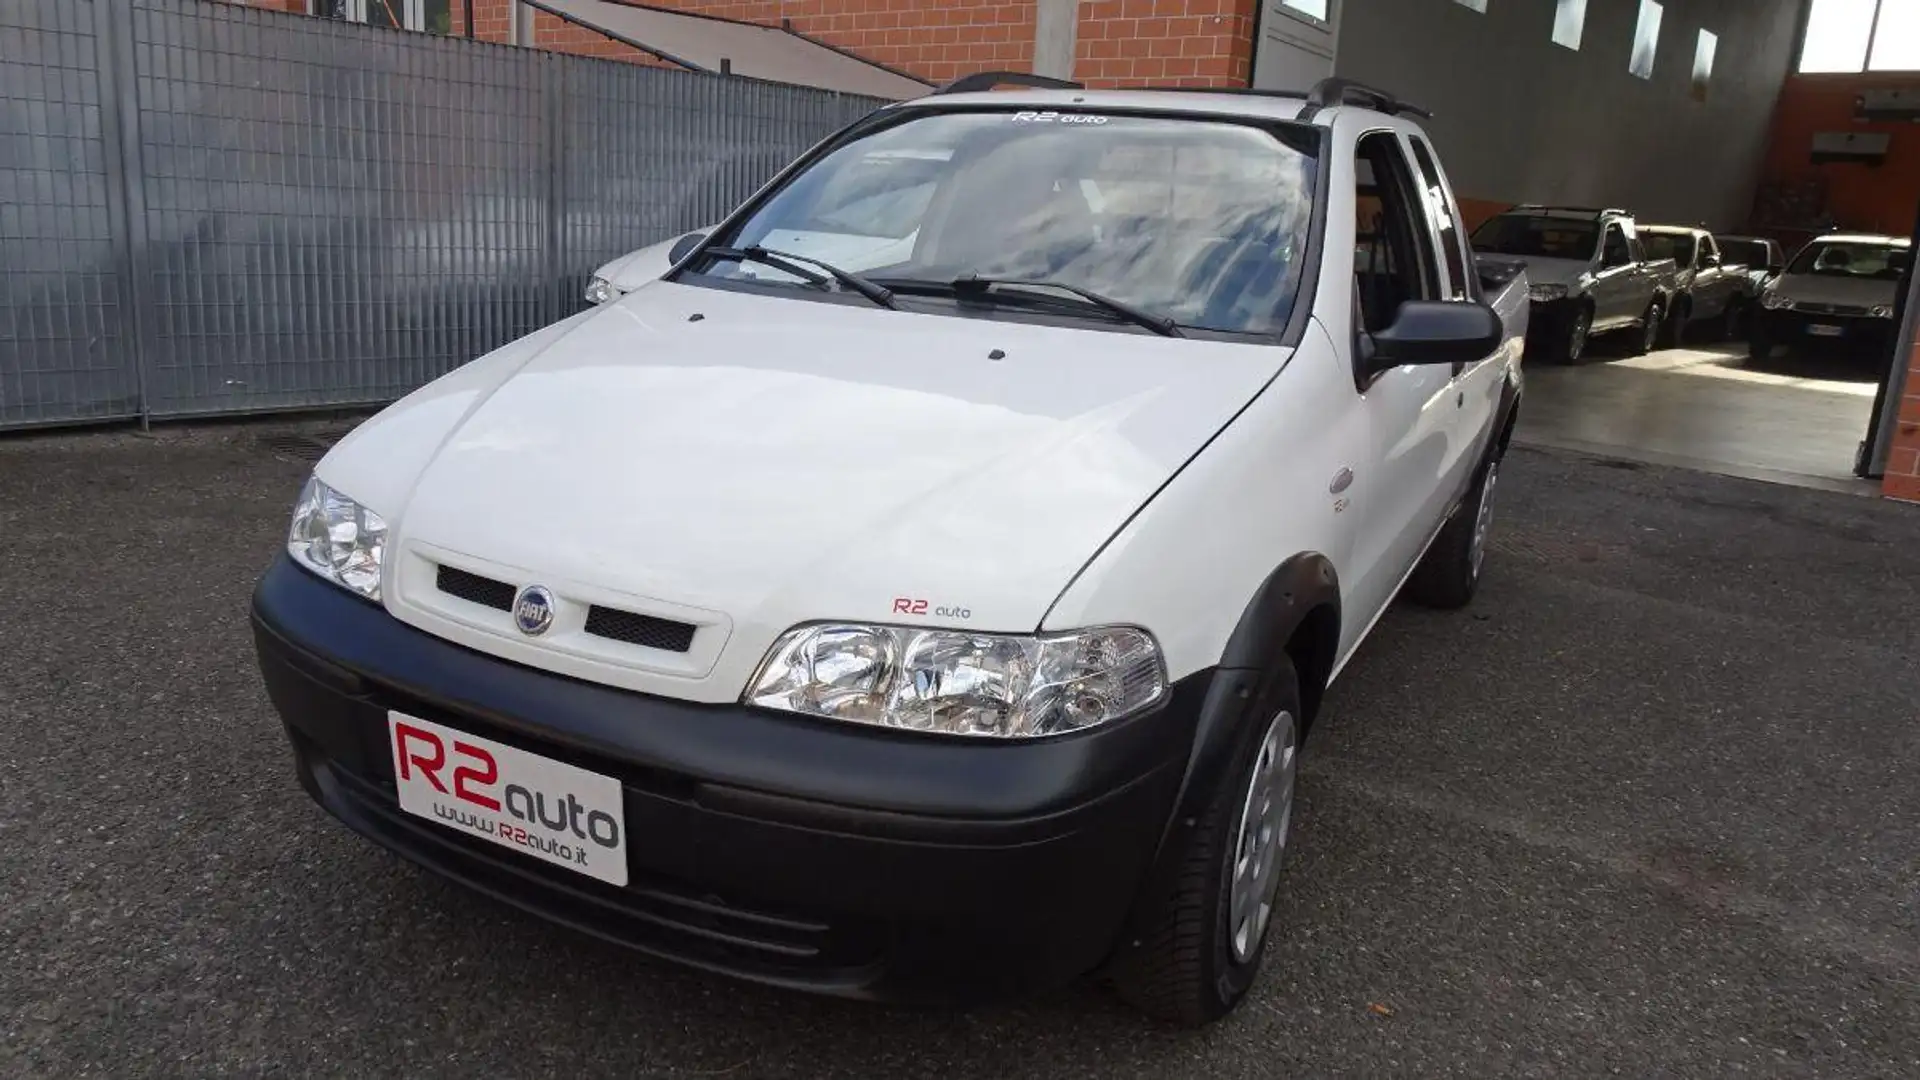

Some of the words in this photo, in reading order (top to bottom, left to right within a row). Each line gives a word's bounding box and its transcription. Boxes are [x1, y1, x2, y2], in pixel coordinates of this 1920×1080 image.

[1012, 111, 1058, 122] R2
[1060, 115, 1108, 124] auto
[519, 600, 549, 621] FIAT
[893, 598, 928, 615] R2
[935, 606, 971, 619] auto
[395, 721, 501, 812] R2
[504, 783, 619, 849] auto
[433, 801, 588, 866] www.R2auto.it
